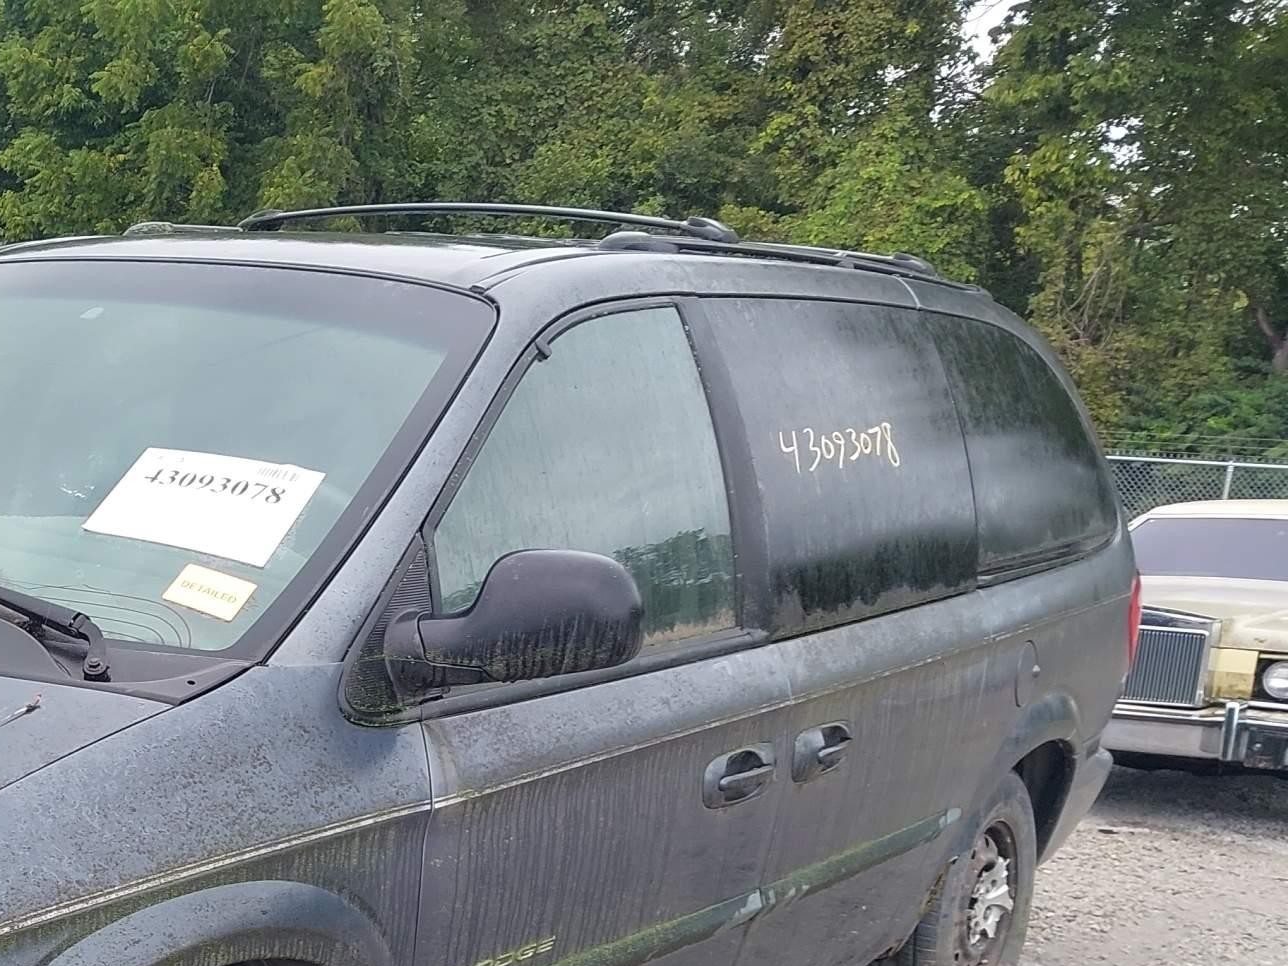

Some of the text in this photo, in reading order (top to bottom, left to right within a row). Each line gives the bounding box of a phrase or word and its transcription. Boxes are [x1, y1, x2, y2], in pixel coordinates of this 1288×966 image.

[779, 422, 900, 474] 43093078
[144, 468, 286, 504] 43093078
[179, 580, 238, 604] DETAILED
